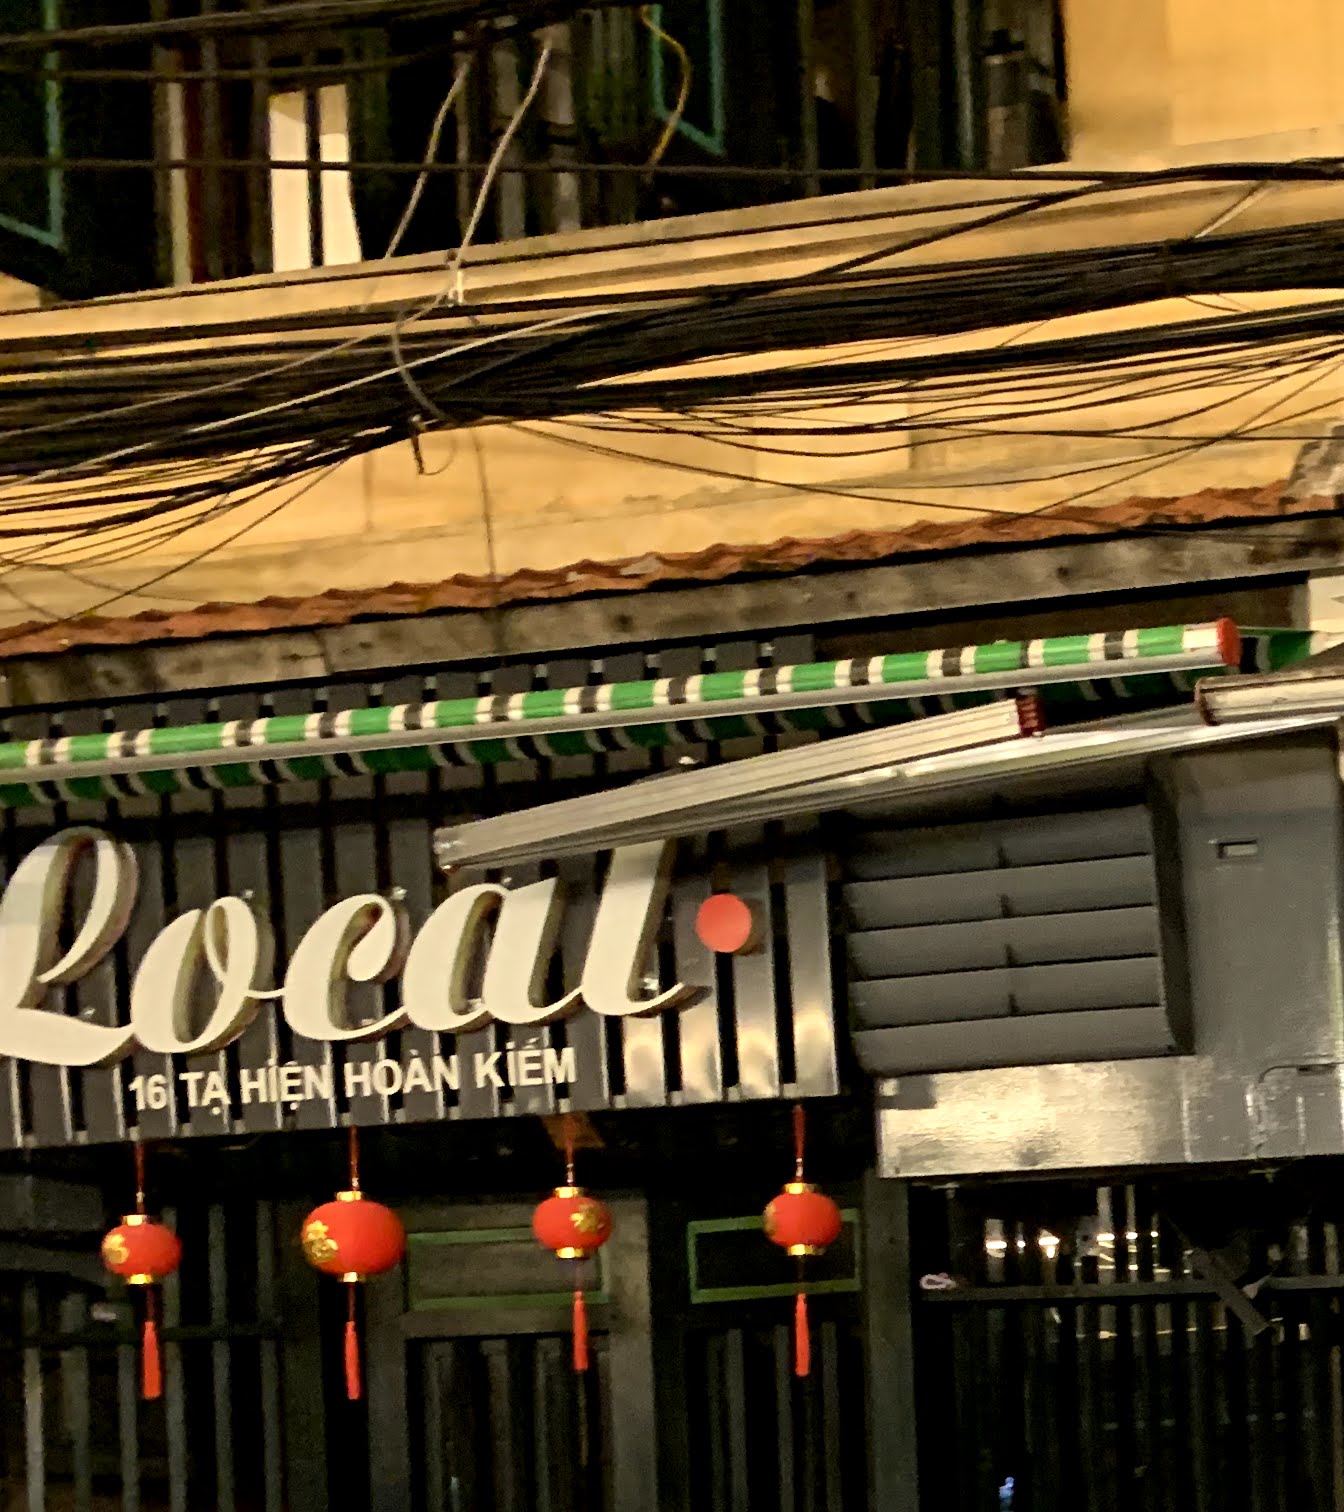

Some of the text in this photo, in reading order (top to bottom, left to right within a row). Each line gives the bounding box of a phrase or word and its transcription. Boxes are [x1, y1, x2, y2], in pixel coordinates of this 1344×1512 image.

[0, 827, 704, 1066] Local
[129, 1074, 168, 1111] 16
[179, 1071, 231, 1116] TẠ
[345, 1049, 460, 1098] HOÀN
